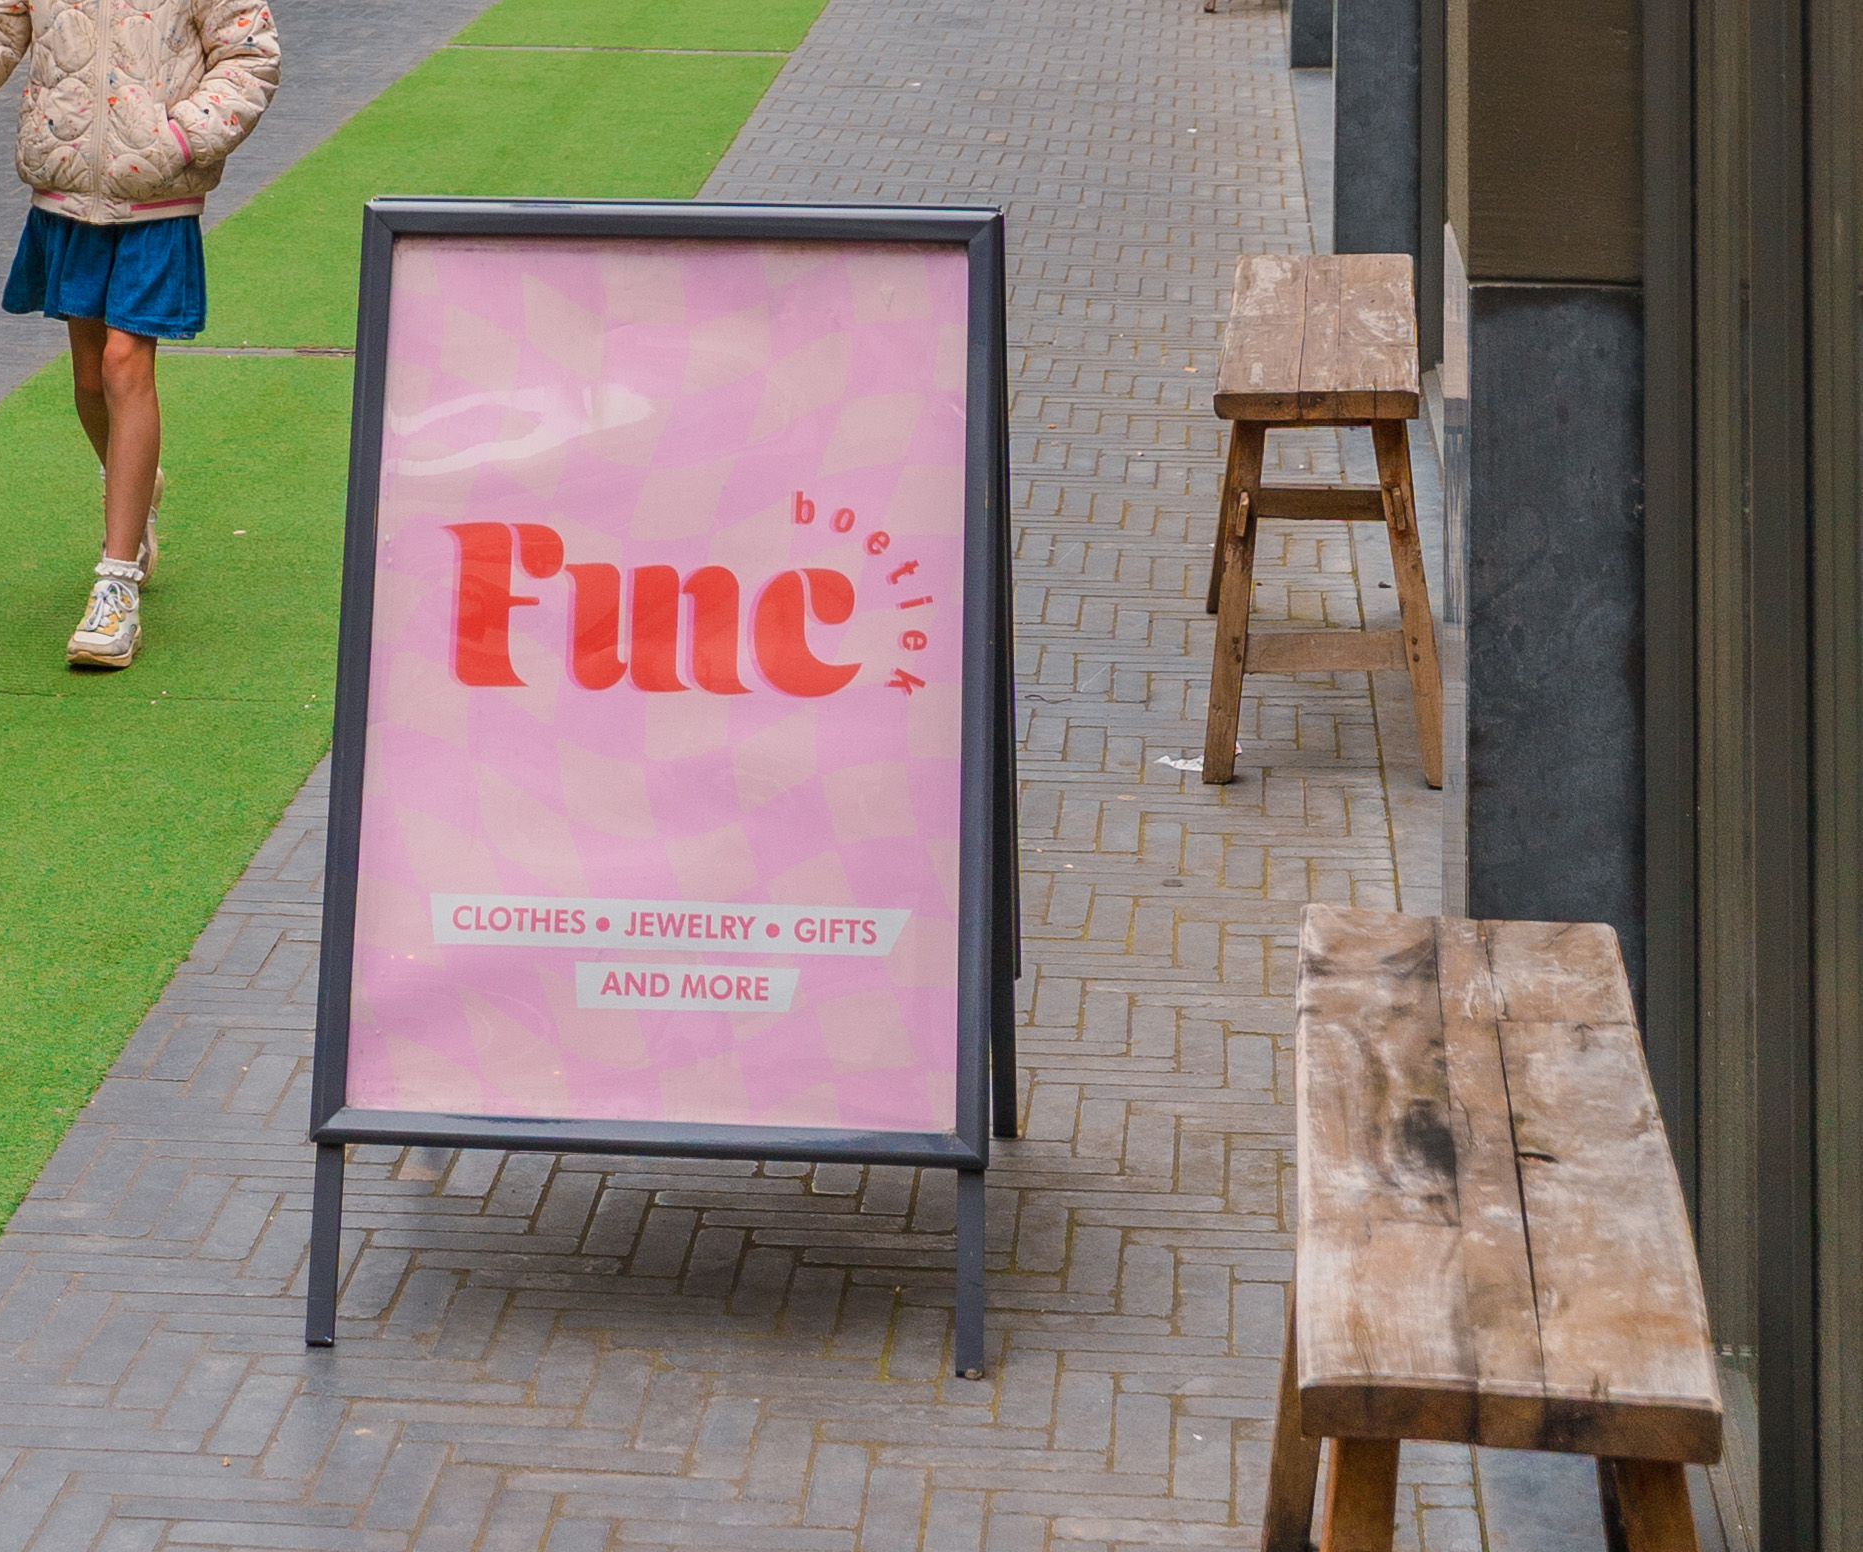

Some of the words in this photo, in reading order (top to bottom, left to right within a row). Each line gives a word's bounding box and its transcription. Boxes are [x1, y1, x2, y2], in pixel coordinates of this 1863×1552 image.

[444, 520, 865, 699] Func
[793, 490, 931, 696] boetiek
[451, 904, 587, 936] CLOTHES
[624, 910, 757, 942] JEWELRY
[794, 916, 878, 946] GIFTS
[600, 970, 671, 999] AND
[681, 972, 771, 1002] MORE
